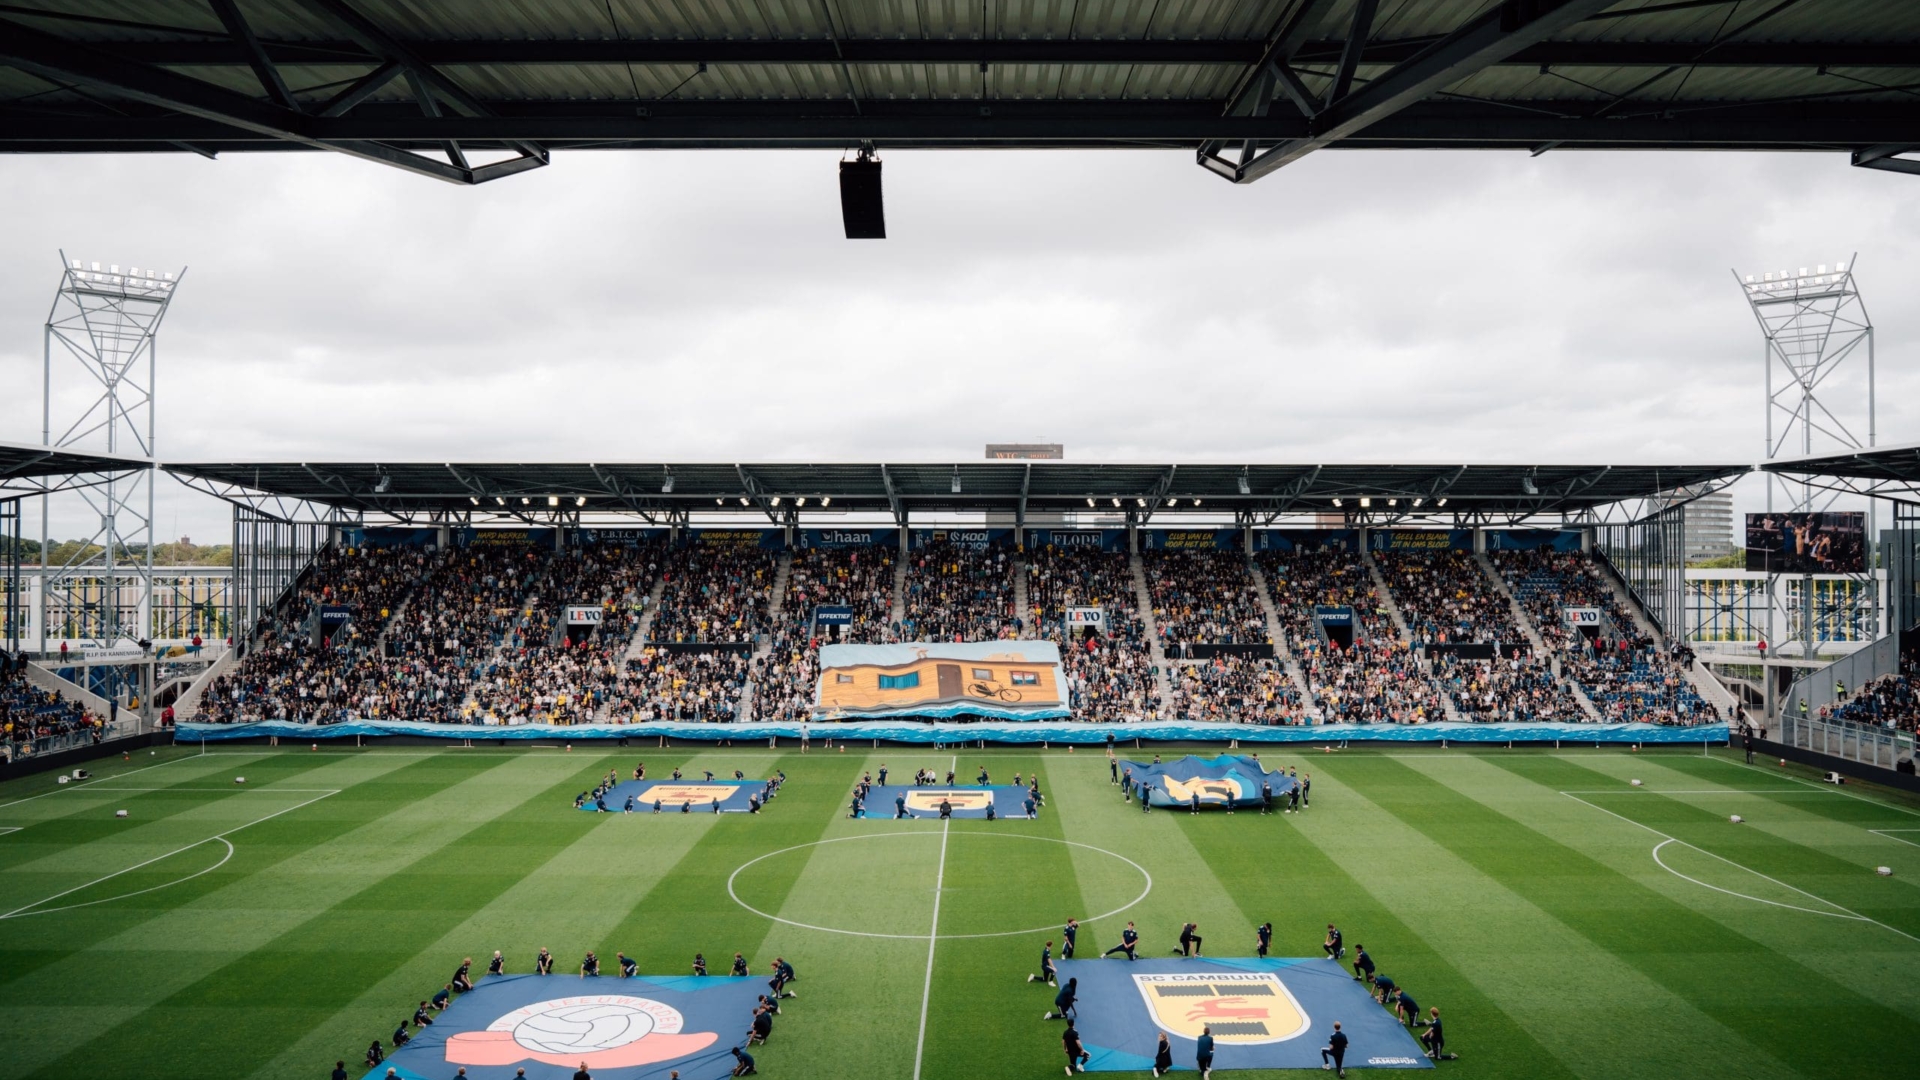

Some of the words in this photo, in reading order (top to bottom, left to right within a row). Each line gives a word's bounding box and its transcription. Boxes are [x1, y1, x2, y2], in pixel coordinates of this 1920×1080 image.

[457, 533, 465, 548] 12
[476, 532, 497, 540] HARD
[497, 532, 528, 540] WERKEN
[600, 530, 635, 539] E.B.T.C.
[699, 532, 732, 540] NIEMAND
[741, 532, 764, 540] MEER
[800, 533, 808, 549] 15
[833, 530, 872, 543] haan
[915, 533, 923, 549] 16
[1031, 533, 1039, 549] 17
[1396, 533, 1415, 541] GEEL
[1415, 533, 1426, 541] EN
[1426, 533, 1451, 541] BLAUW
[1145, 534, 1153, 549] 18
[1164, 540, 1183, 548] VOOR
[1183, 540, 1199, 548] HET
[1260, 534, 1268, 549] 19
[1373, 534, 1384, 549] 20
[1390, 541, 1402, 549] ZIT
[1402, 541, 1410, 549] IN
[1410, 541, 1426, 549] ONS
[1426, 541, 1451, 549] BLOED
[1493, 534, 1500, 549] 21
[570, 611, 601, 620] LEVO
[1068, 611, 1101, 621] LEVO
[1565, 611, 1597, 621] LEVO
[548, 996, 678, 1030] LEEUWARDEN
